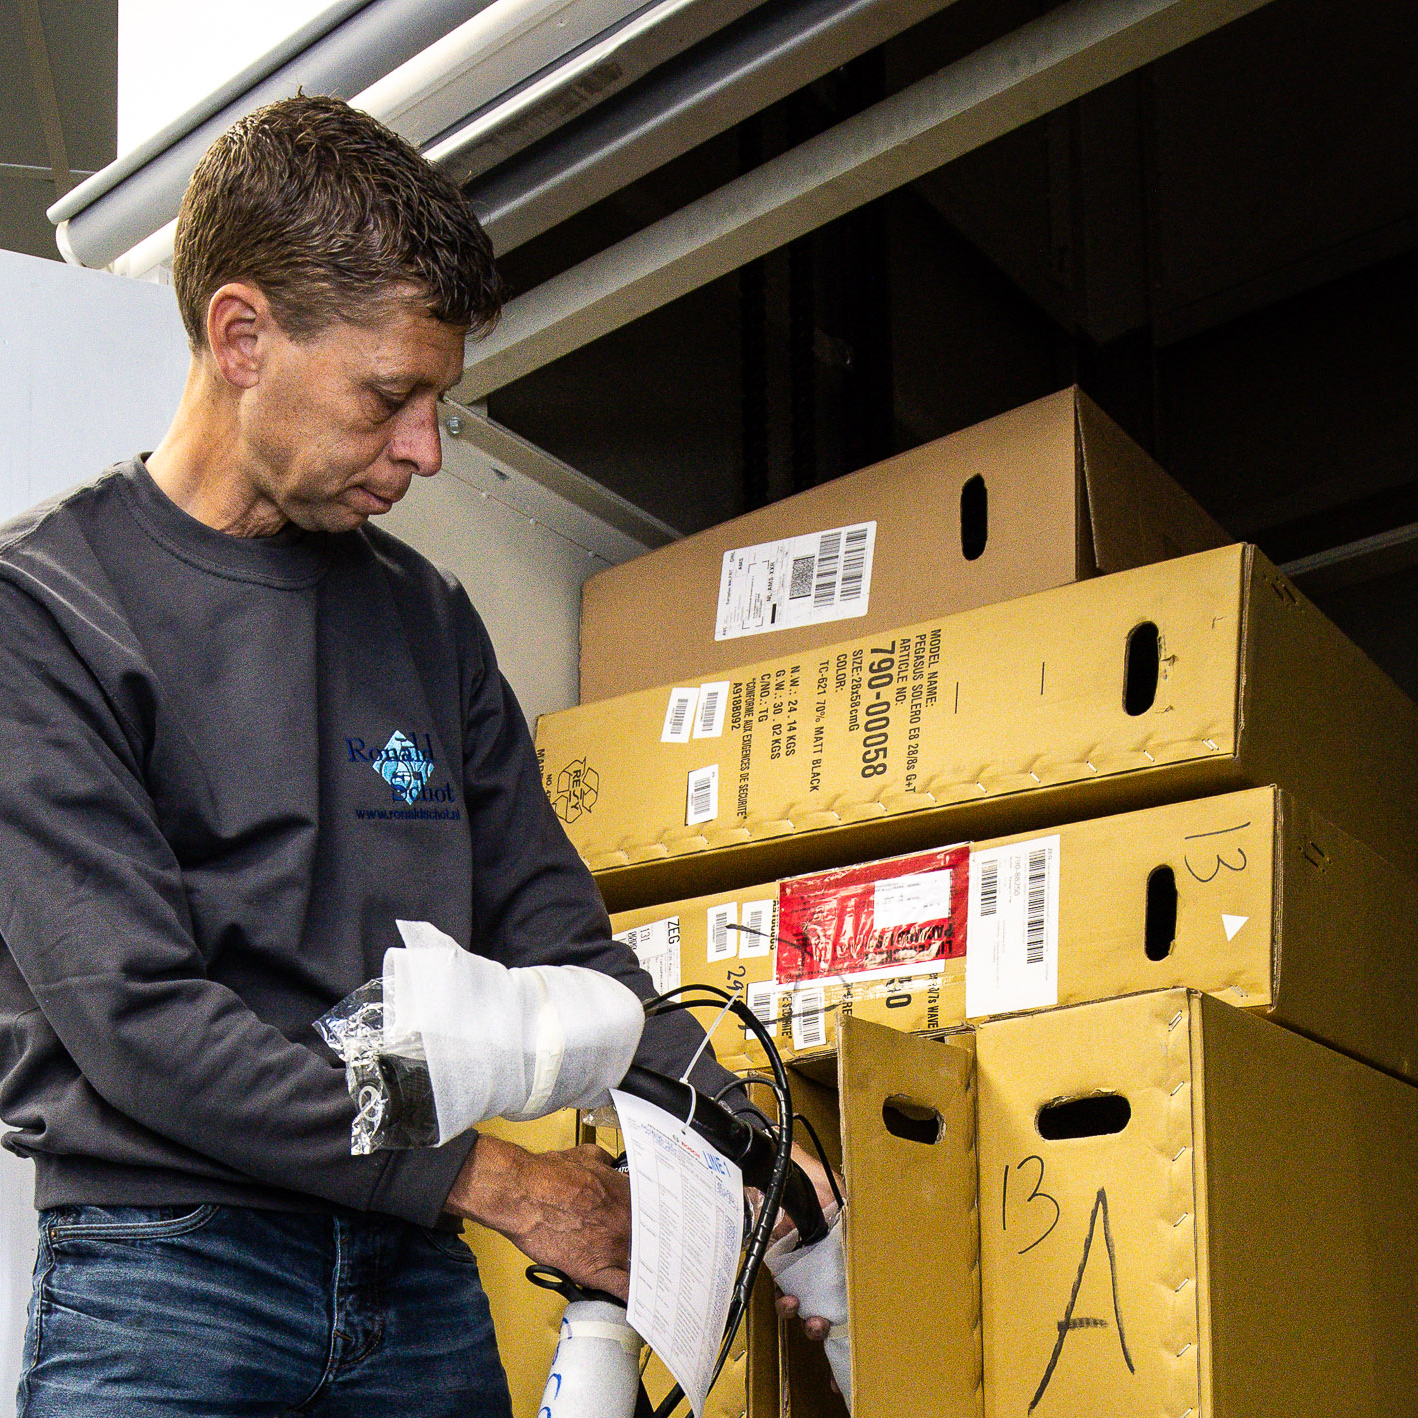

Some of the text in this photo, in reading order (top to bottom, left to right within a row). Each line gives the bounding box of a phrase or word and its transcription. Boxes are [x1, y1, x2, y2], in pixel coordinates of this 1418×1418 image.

[835, 653, 848, 693] COLOR:
[895, 638, 911, 707] ARTICLE NO:
[925, 628, 942, 708] MODEL NAME:
[731, 682, 743, 731] A918B092
[757, 673, 772, 723] C/NO.: TG
[860, 640, 896, 779] 790-00058
[905, 633, 926, 793] PEGASUS SOLERO E8 28/8s G+T
[345, 732, 435, 762] Ronald
[743, 720, 754, 733] AUX
[785, 733, 797, 757] KGS
[809, 660, 830, 793] TC-621 70% MATT BLACK
[740, 734, 753, 772] EXIGENCES
[769, 738, 782, 760] KGS
[391, 772, 456, 803] Schot
[739, 773, 750, 783] DE
[1184, 821, 1252, 883] 13
[667, 918, 680, 945] ZEG
[927, 1005, 939, 1029] WAVE
[1003, 1155, 1060, 1255] 13
[1027, 1186, 1136, 1417] A
